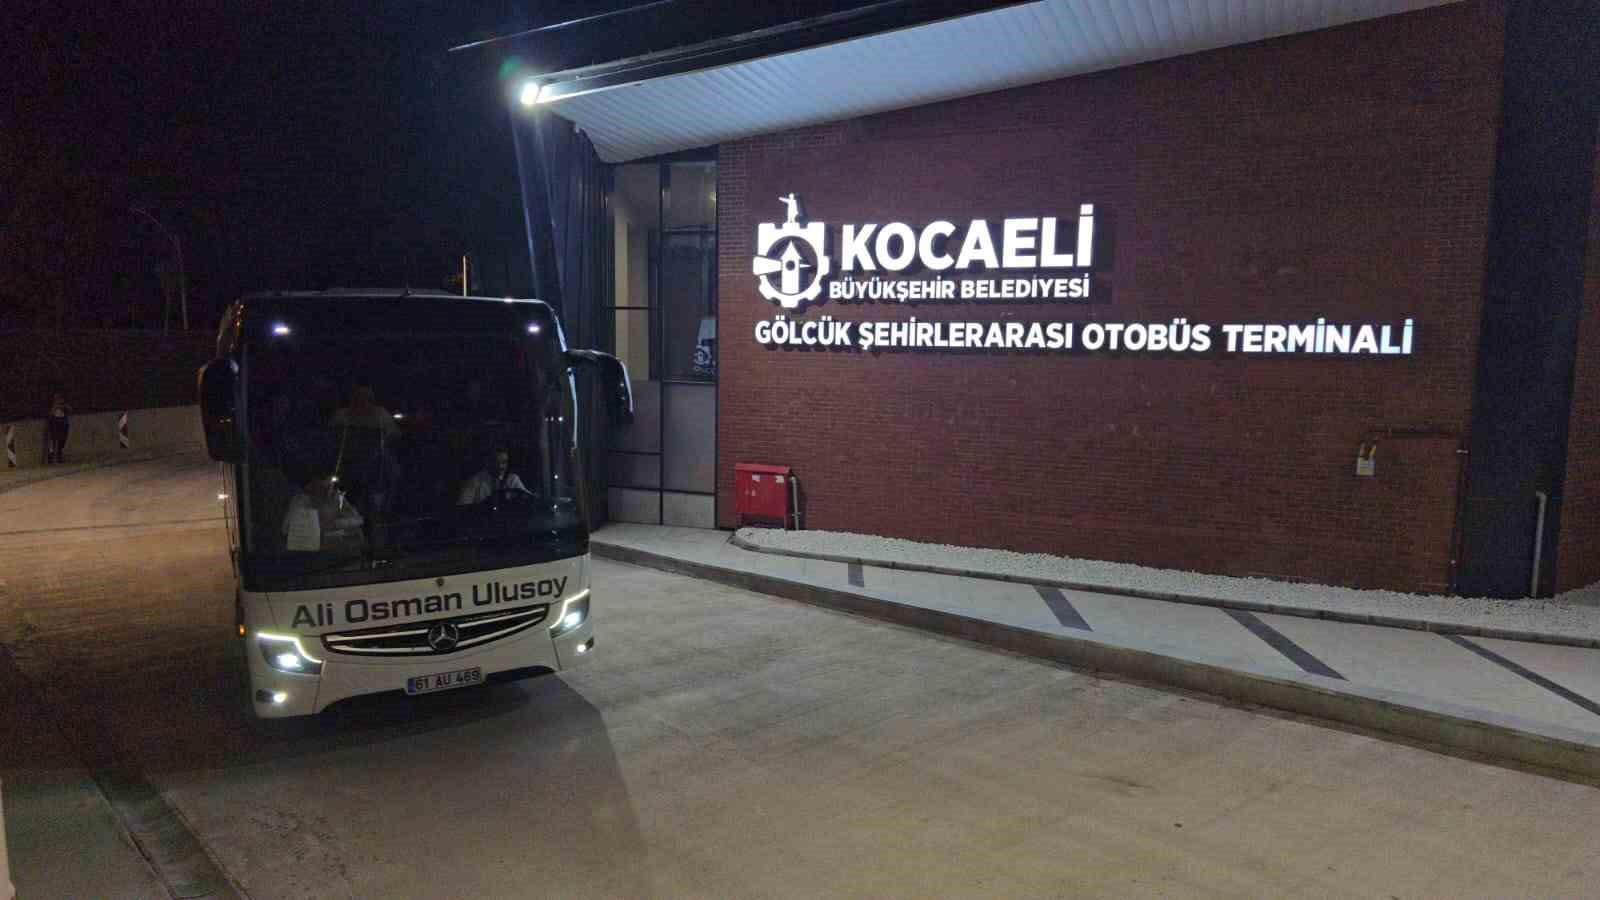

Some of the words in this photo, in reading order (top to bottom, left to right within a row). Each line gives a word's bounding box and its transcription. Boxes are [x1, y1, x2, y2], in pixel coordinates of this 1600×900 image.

[841, 203, 1094, 271] KOCAELİ
[829, 276, 955, 302] BÜYÜKŞEHİR
[961, 273, 1090, 299] BELEDİYESİ
[755, 315, 851, 345] GÖLCÜK
[858, 317, 1073, 350] ŞEHİRLERARASI
[1082, 318, 1211, 352] OTOBÜS
[1223, 317, 1413, 354] TERMİNALİ
[291, 604, 334, 628] Ali
[345, 592, 462, 623] Osman
[472, 576, 568, 607] Ulusoy
[416, 678, 429, 689] 61
[436, 674, 452, 687] AU
